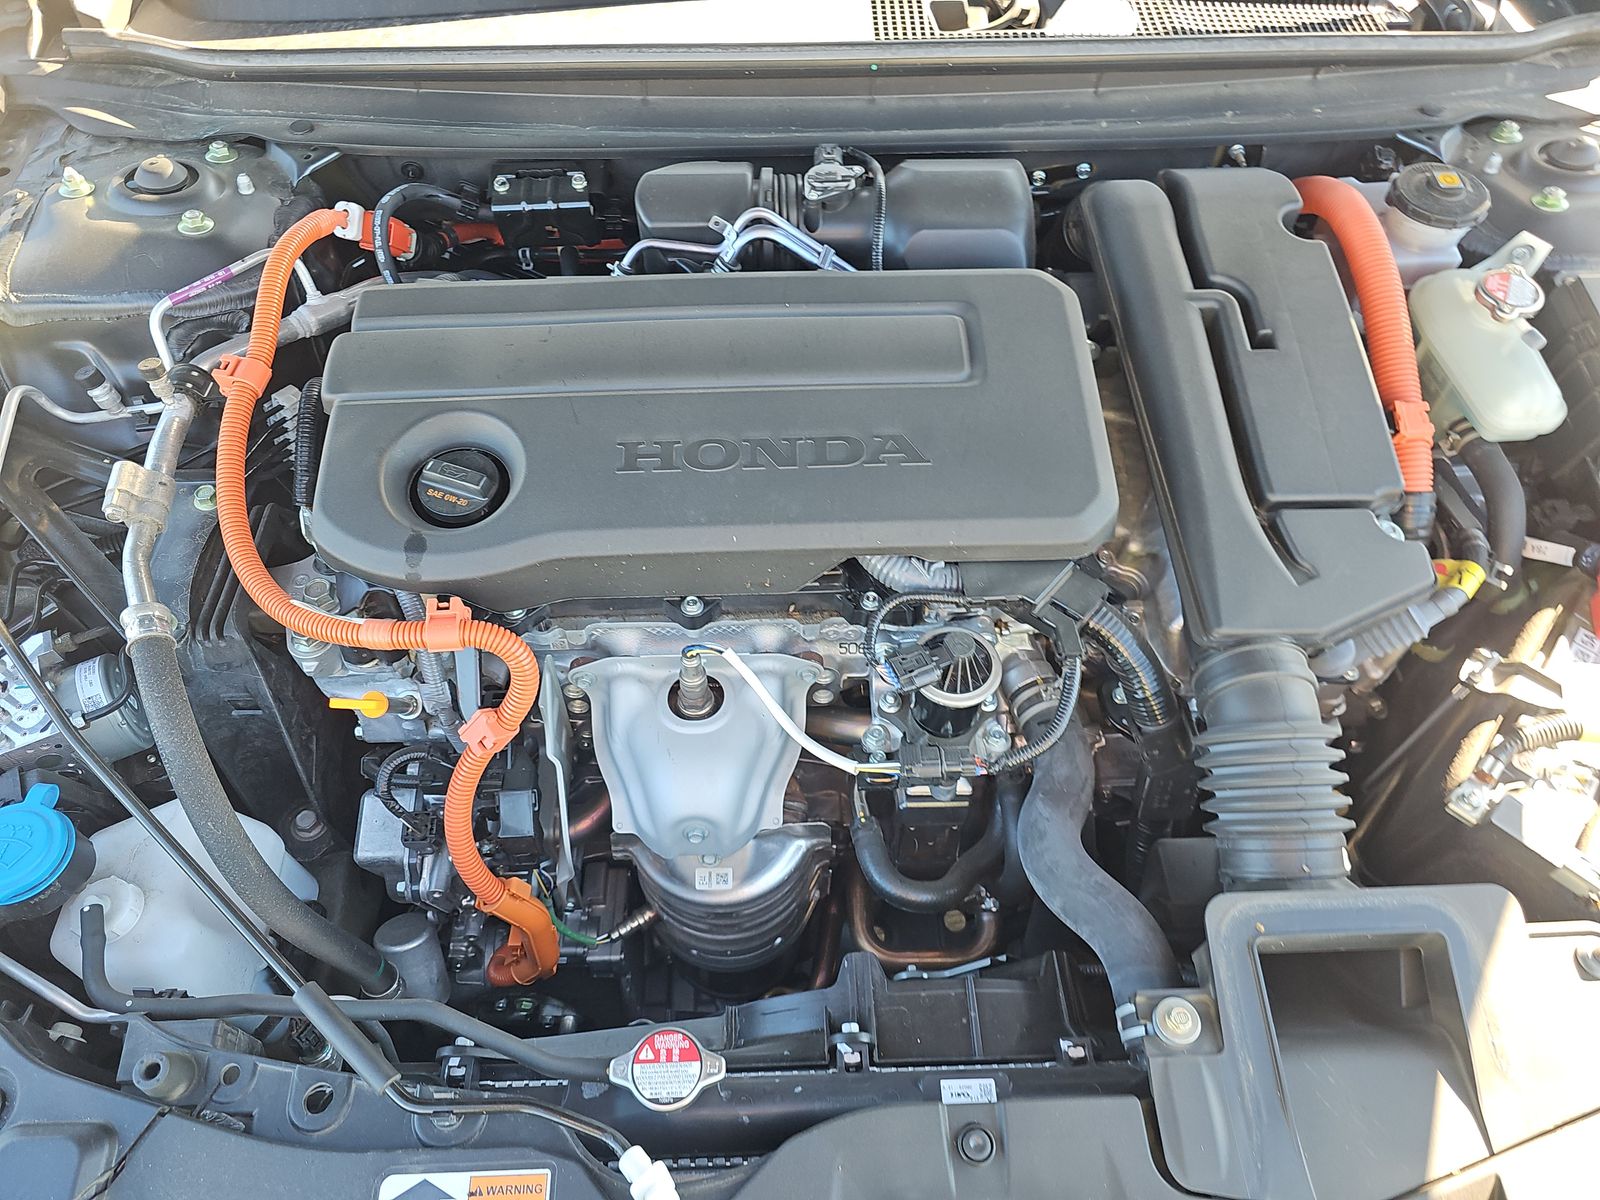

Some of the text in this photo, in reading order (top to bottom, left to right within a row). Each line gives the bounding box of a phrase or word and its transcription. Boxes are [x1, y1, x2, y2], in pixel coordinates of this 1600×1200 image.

[615, 433, 933, 475] HONDA
[426, 488, 469, 507] SAE 0W-20
[655, 1034, 683, 1042] DANGER
[486, 1183, 543, 1196] WARNING
